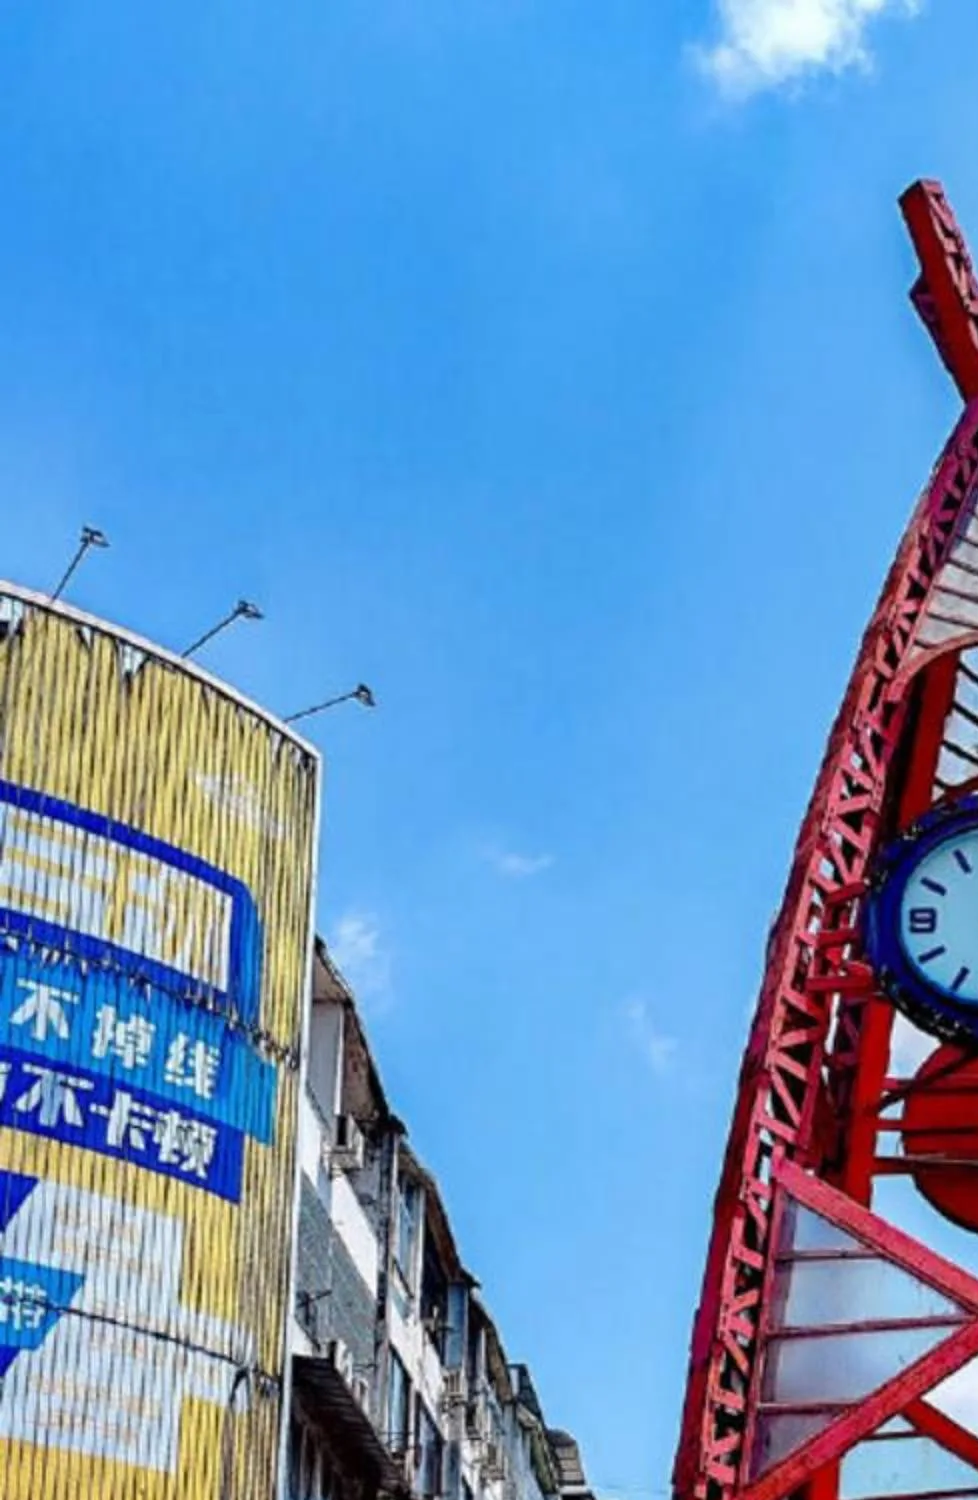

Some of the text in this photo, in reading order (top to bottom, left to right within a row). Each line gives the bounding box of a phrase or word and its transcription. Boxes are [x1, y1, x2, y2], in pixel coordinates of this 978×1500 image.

[909, 908, 937, 933] 9
[10, 978, 221, 1099] 不掉线
[0, 1062, 218, 1178] 不卡顿
